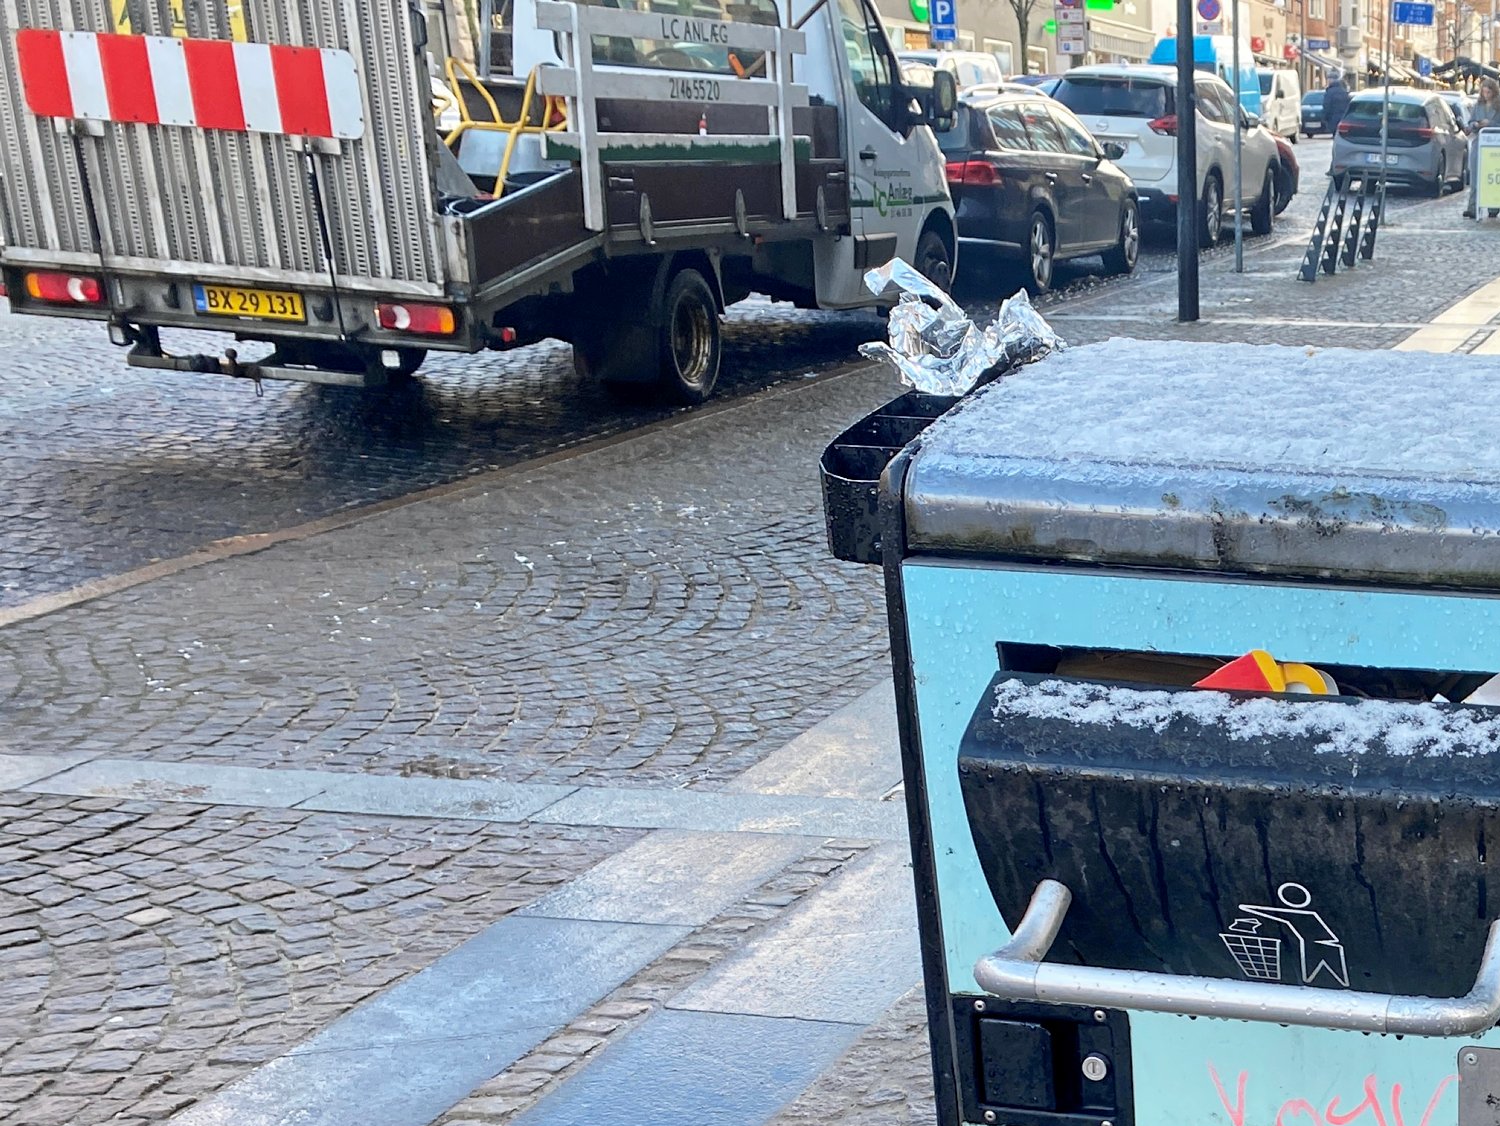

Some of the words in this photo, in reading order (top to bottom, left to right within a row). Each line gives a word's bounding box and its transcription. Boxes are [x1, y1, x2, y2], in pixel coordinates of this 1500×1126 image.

[936, 1, 950, 23] P
[661, 17, 680, 39] LC
[683, 20, 728, 43] ANLÆG
[207, 289, 233, 310] BX
[237, 292, 259, 312] 29
[265, 294, 299, 316] 131
